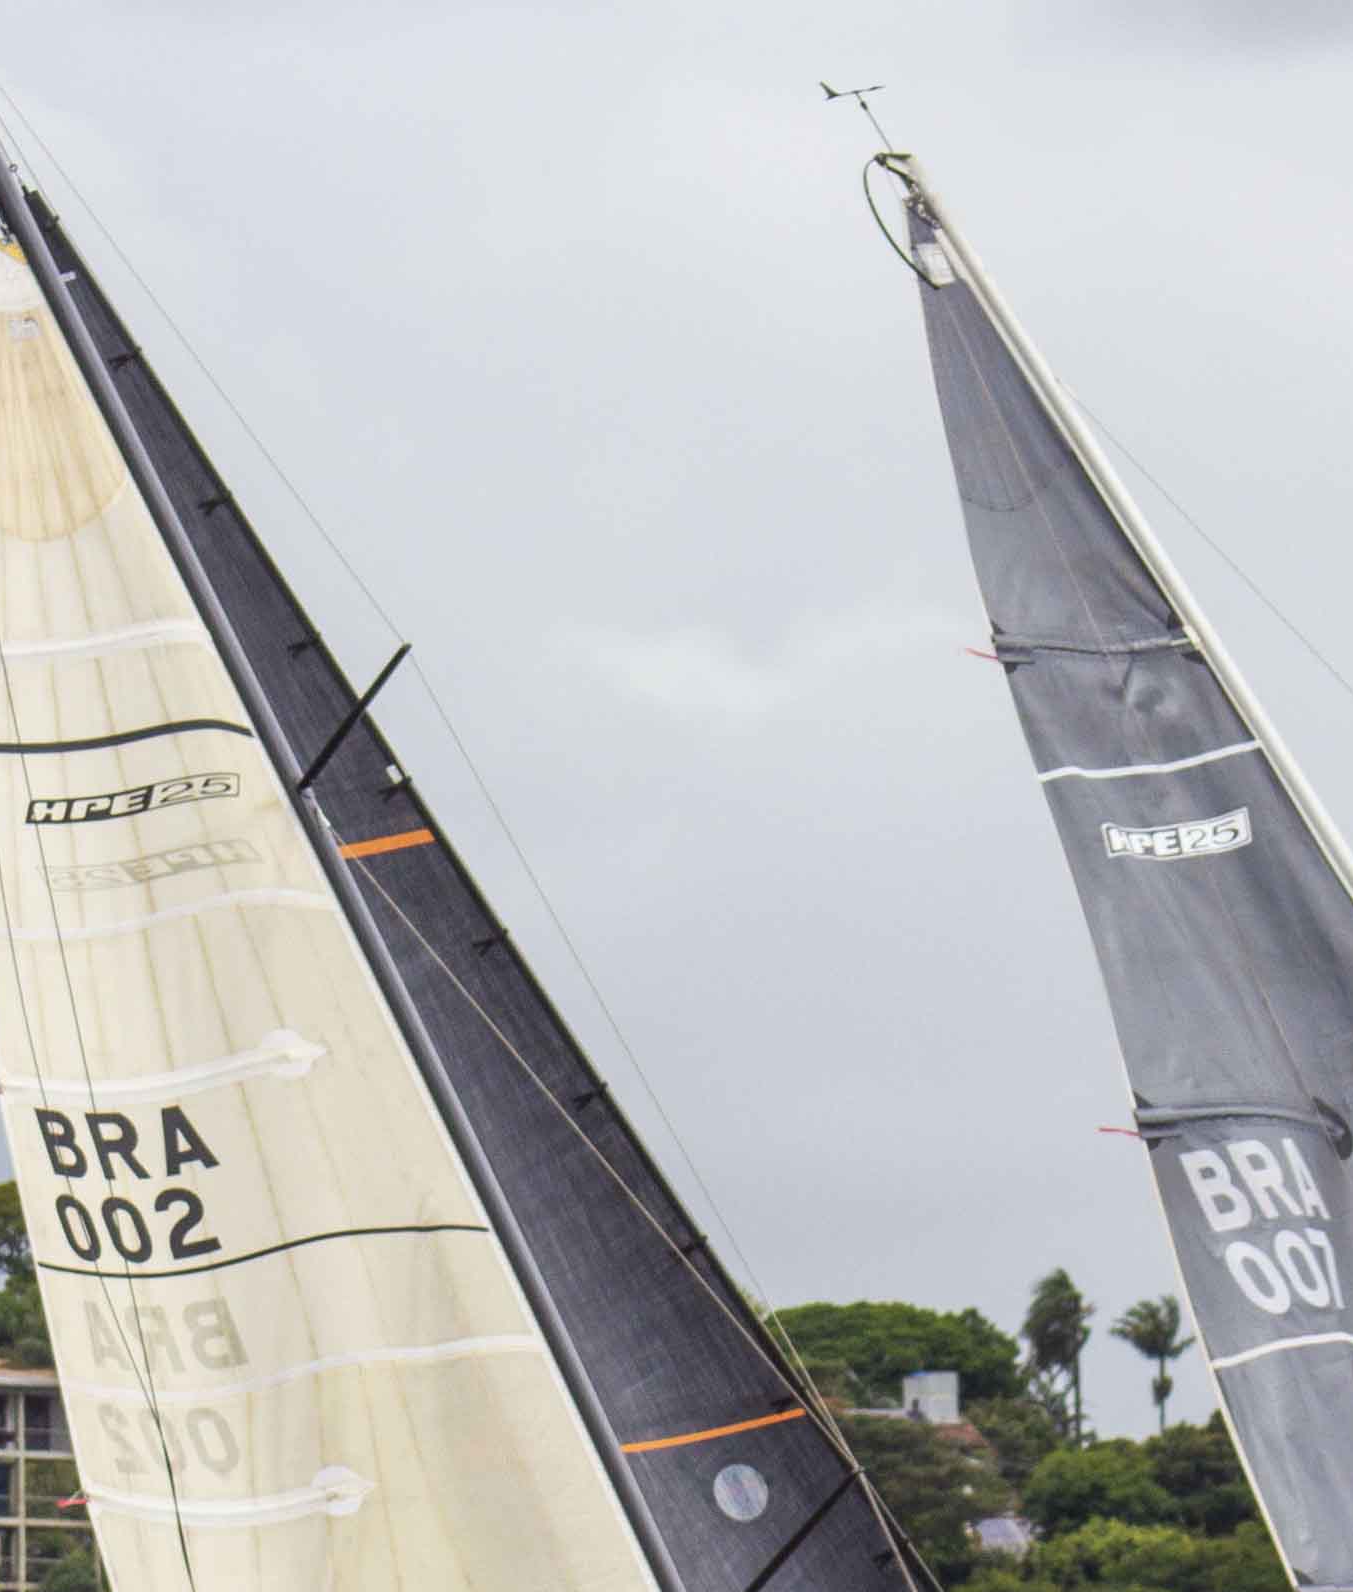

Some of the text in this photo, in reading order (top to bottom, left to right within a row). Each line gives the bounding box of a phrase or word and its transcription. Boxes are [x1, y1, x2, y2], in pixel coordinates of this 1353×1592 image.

[34, 1105, 221, 1181] BRA
[55, 1187, 222, 1263] 002
[1178, 1138, 1331, 1232] BRA
[1225, 1227, 1345, 1315] 007
